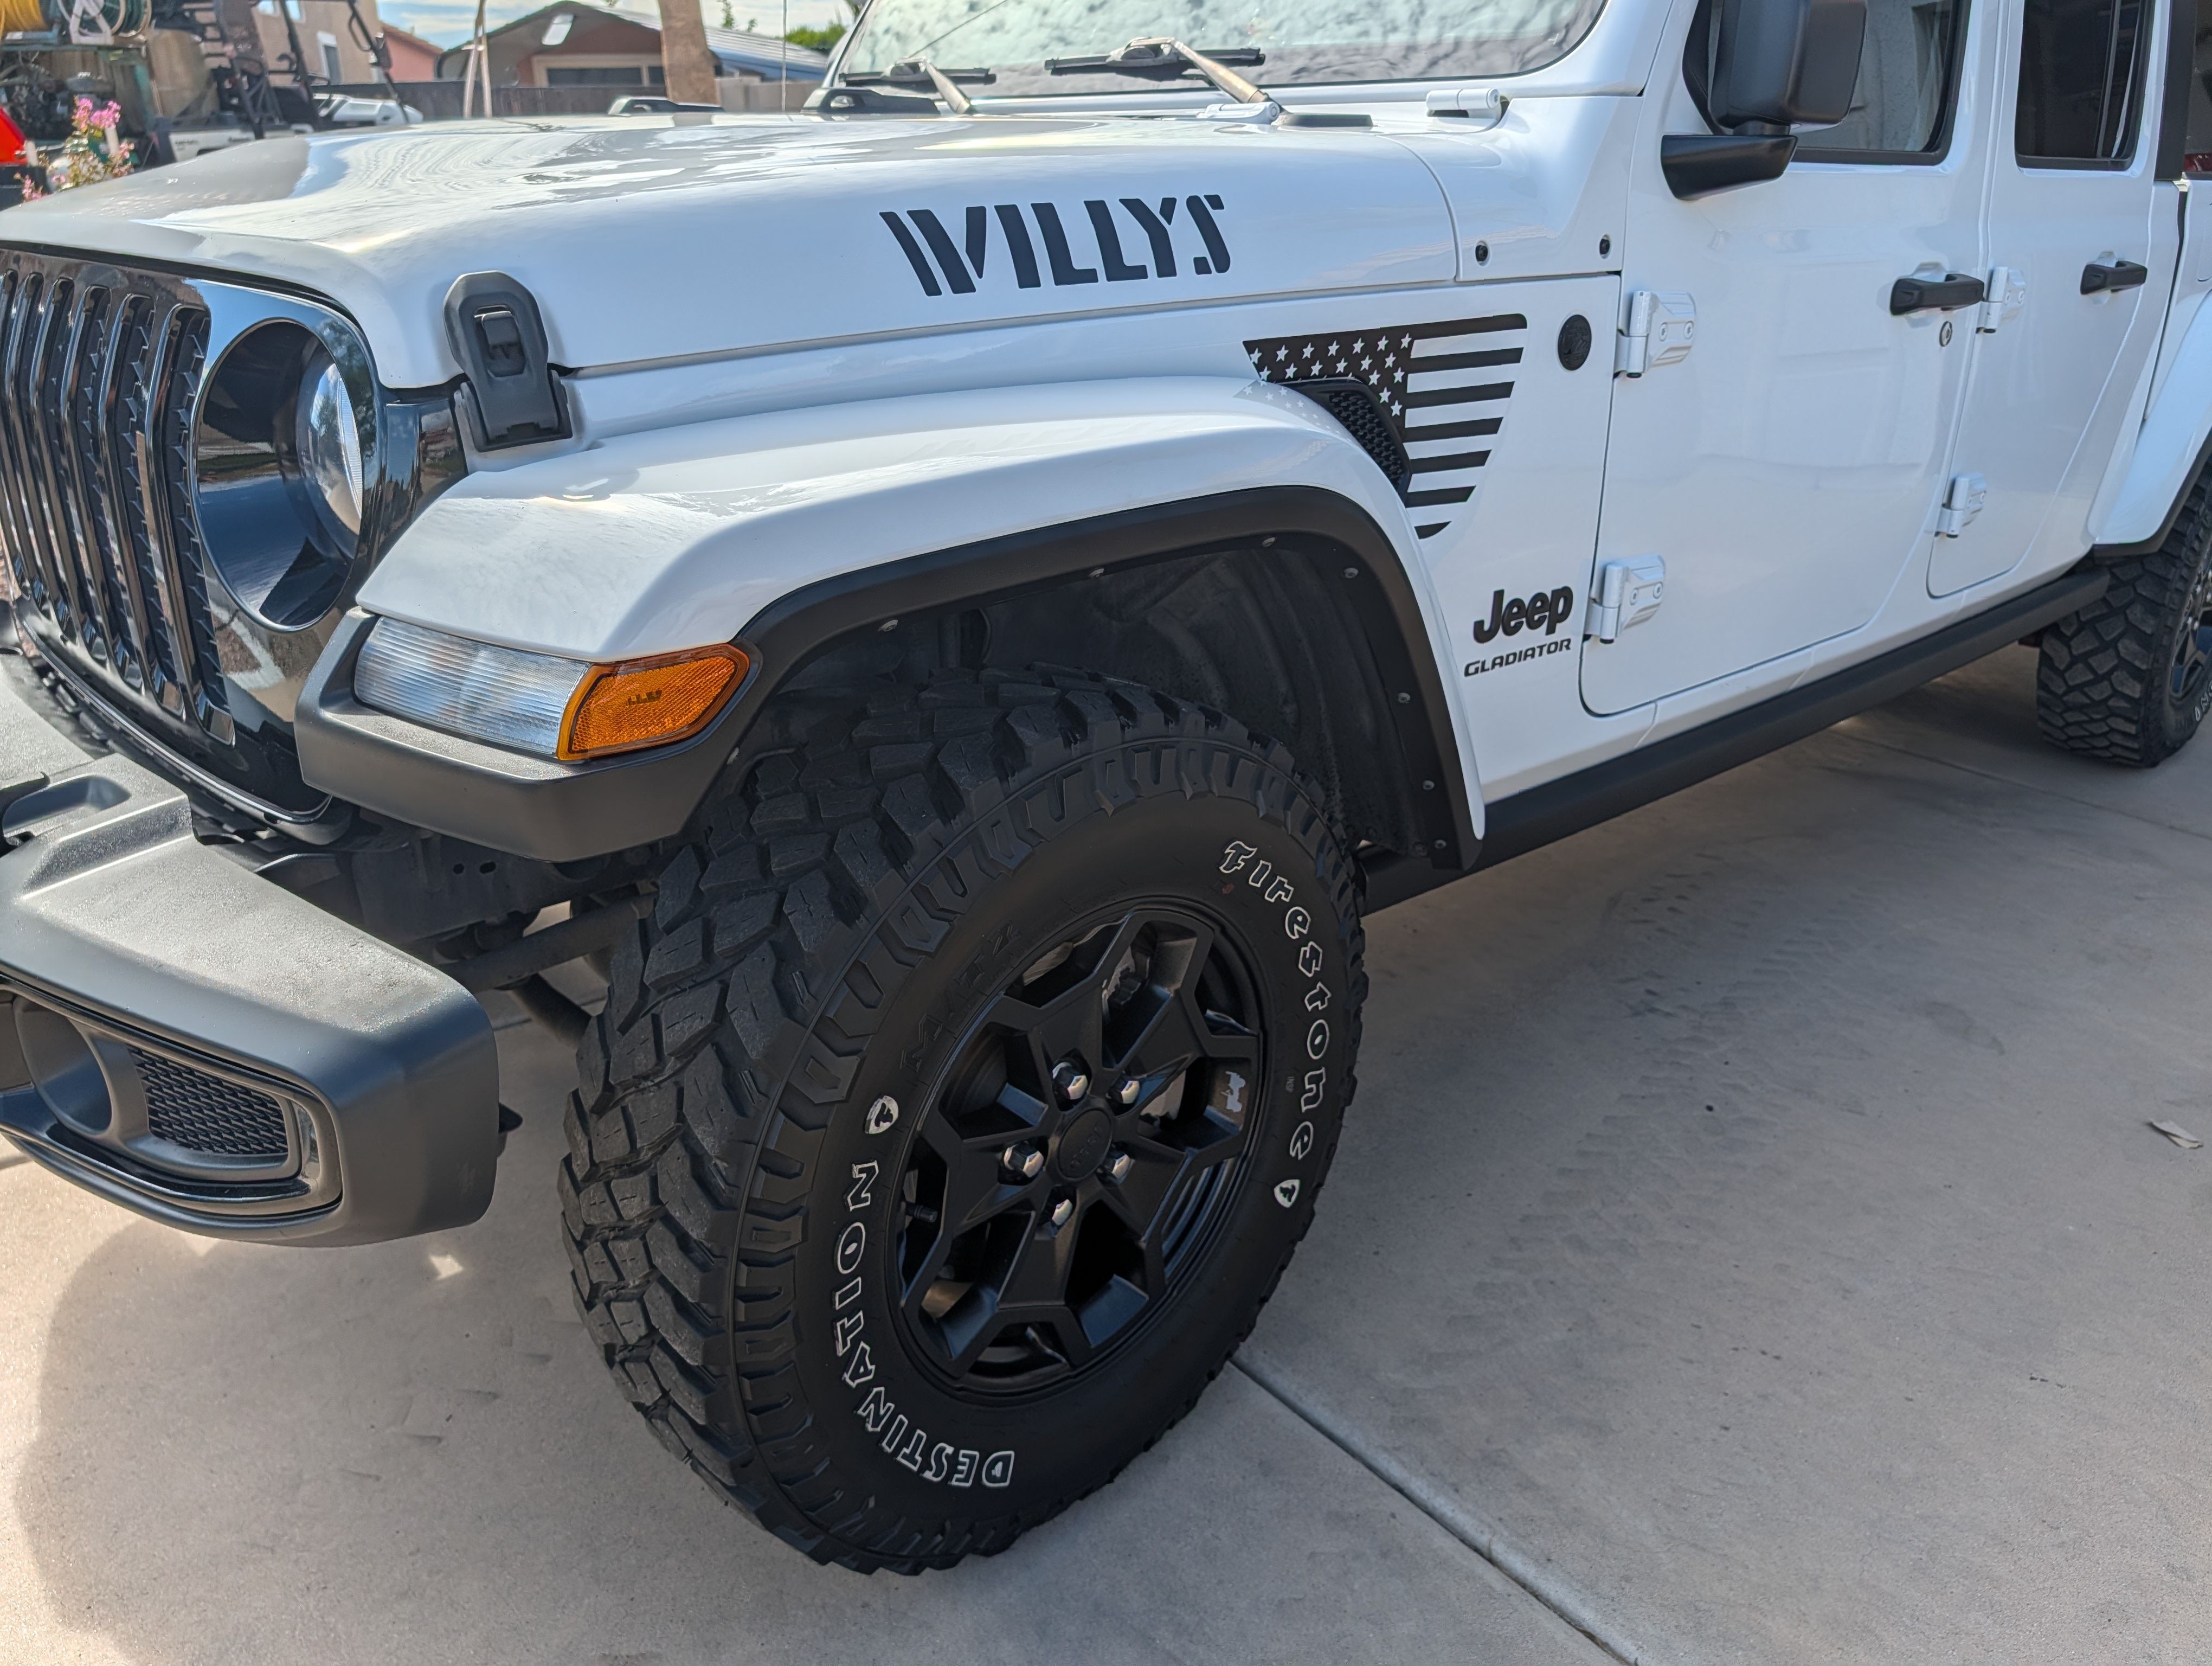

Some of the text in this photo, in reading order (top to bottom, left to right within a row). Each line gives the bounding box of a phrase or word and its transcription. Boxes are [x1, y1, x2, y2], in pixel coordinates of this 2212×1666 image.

[879, 194, 1231, 297] WILLYS
[1464, 638, 1572, 677] GLADIATOR
[1473, 586, 1573, 644] Jeep
[1219, 841, 1332, 1159] Firestone
[832, 1159, 1015, 1488] DESTINATION
